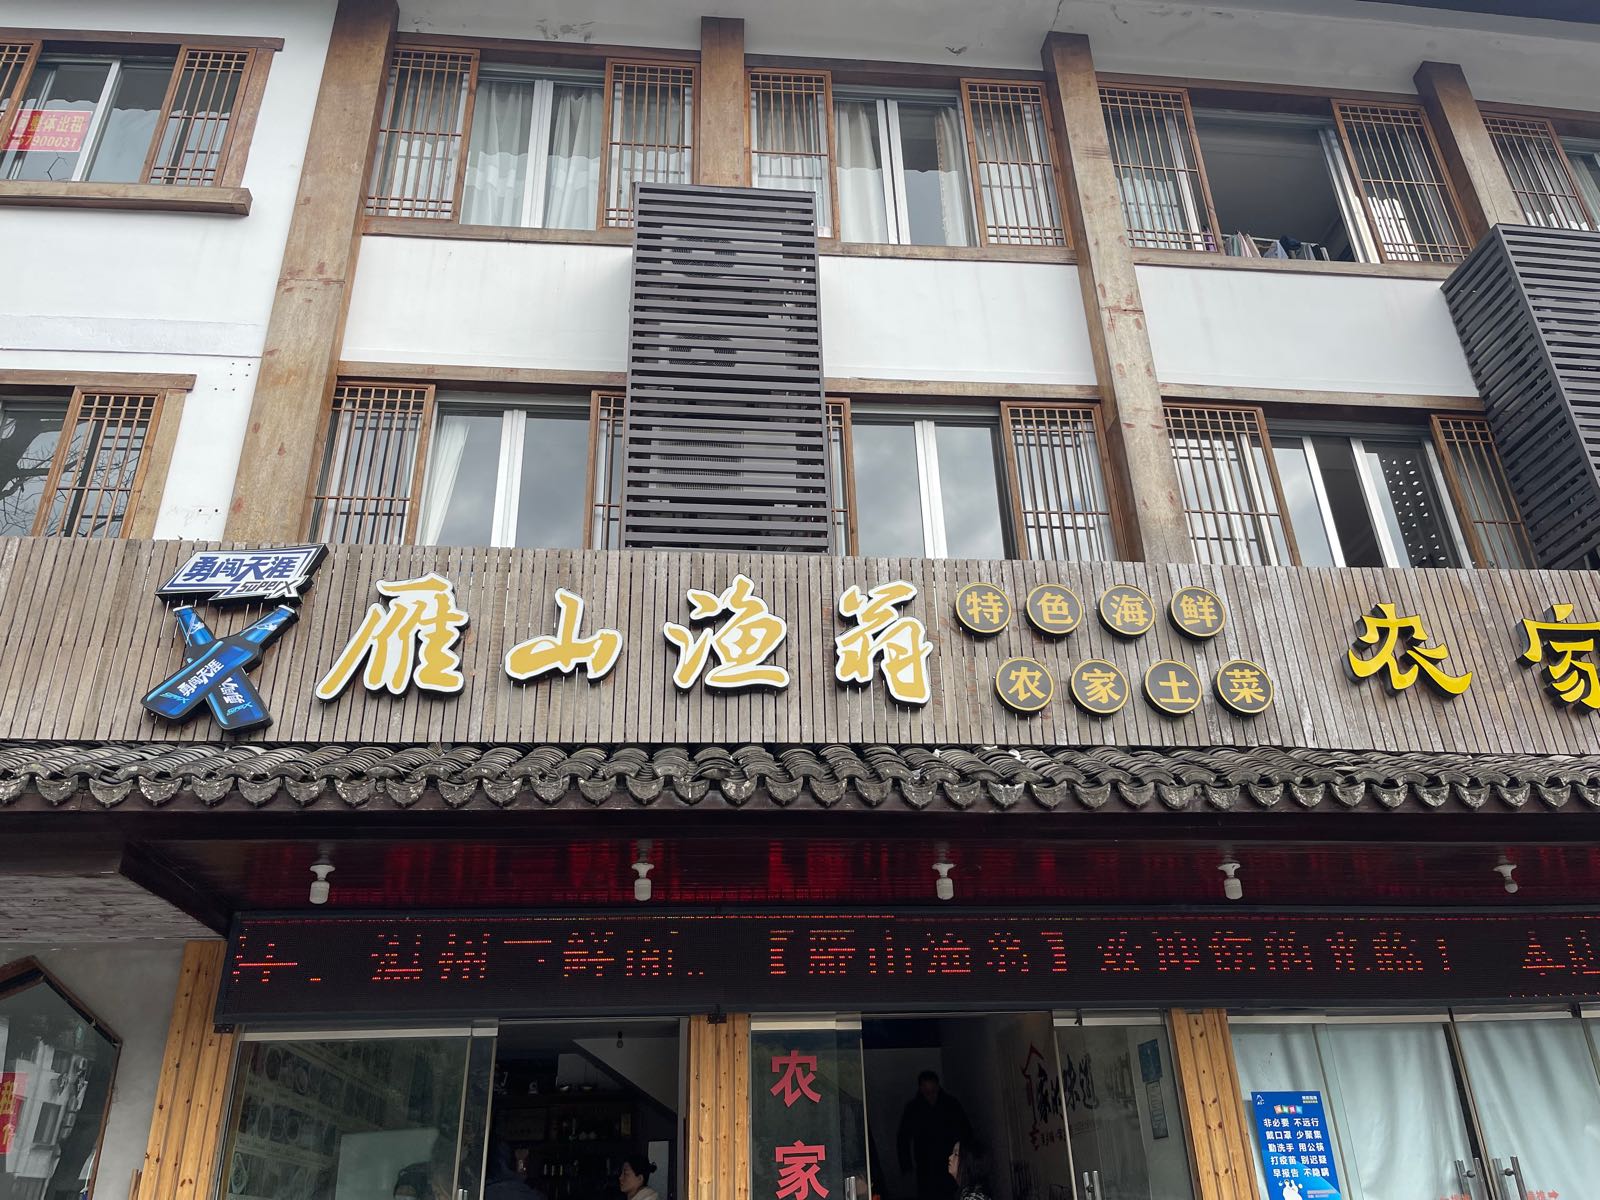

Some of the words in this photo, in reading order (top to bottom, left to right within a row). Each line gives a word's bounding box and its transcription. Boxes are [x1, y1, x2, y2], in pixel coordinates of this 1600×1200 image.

[17, 113, 85, 133] 整体出租
[183, 556, 300, 582] 勇闯天涯
[964, 590, 1219, 630] 特色海鲜
[316, 573, 932, 704] 雁山渔翁
[1347, 602, 1600, 709] 农家
[1007, 666, 1268, 705] 农家土菜
[769, 1050, 830, 1200] 农家
[1263, 1118, 1290, 1127] 非必要
[1293, 1117, 1319, 1127] 不远行
[1265, 1130, 1292, 1140] 戴口罩
[1296, 1130, 1322, 1139] 少聚集
[1268, 1143, 1294, 1152] 勤洗手
[1270, 1156, 1297, 1165] 打疫苗
[1273, 1168, 1299, 1178] 早报告
